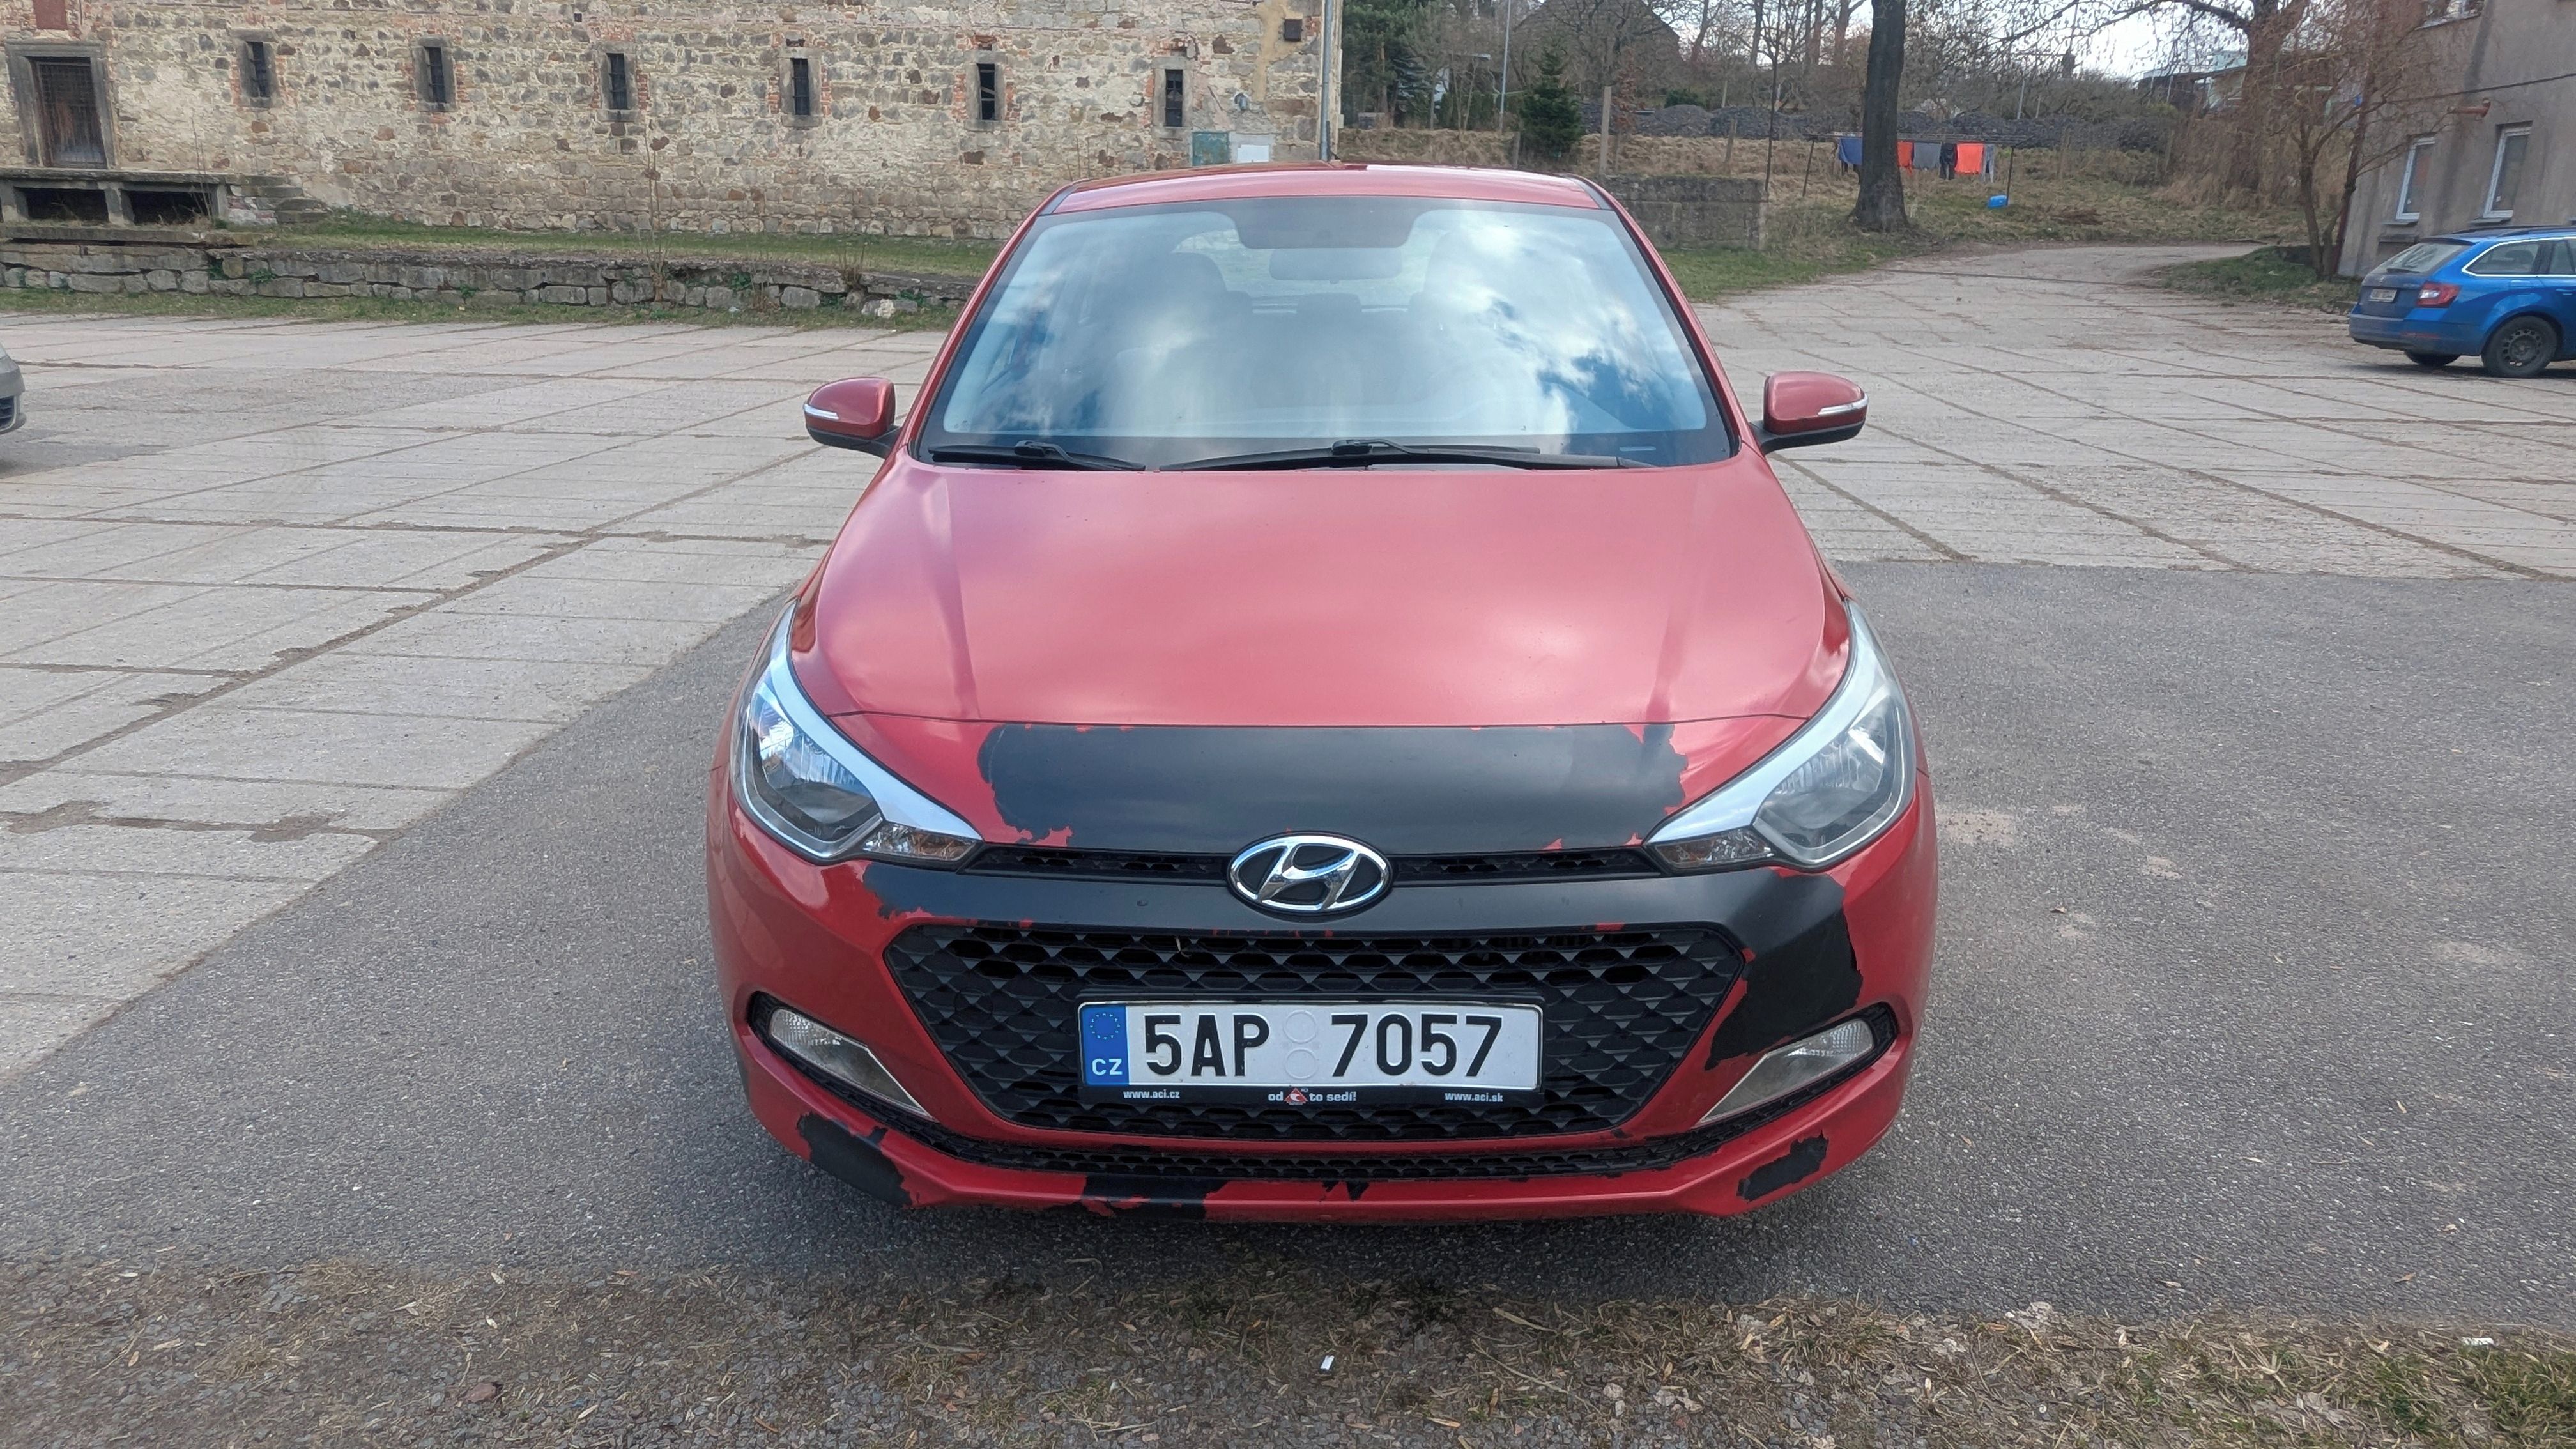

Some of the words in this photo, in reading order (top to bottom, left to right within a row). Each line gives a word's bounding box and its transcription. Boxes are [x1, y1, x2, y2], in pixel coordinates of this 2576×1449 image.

[1144, 1014, 1269, 1077] 5AP
[1331, 1012, 1503, 1077] 7057
[1092, 1058, 1123, 1075] CZ
[1123, 1089, 1180, 1099] www.aci.cz
[1268, 1091, 1284, 1101] od
[1309, 1092, 1323, 1101] to
[1326, 1091, 1357, 1101] sedí!
[1445, 1092, 1503, 1102] www.aci.sk
